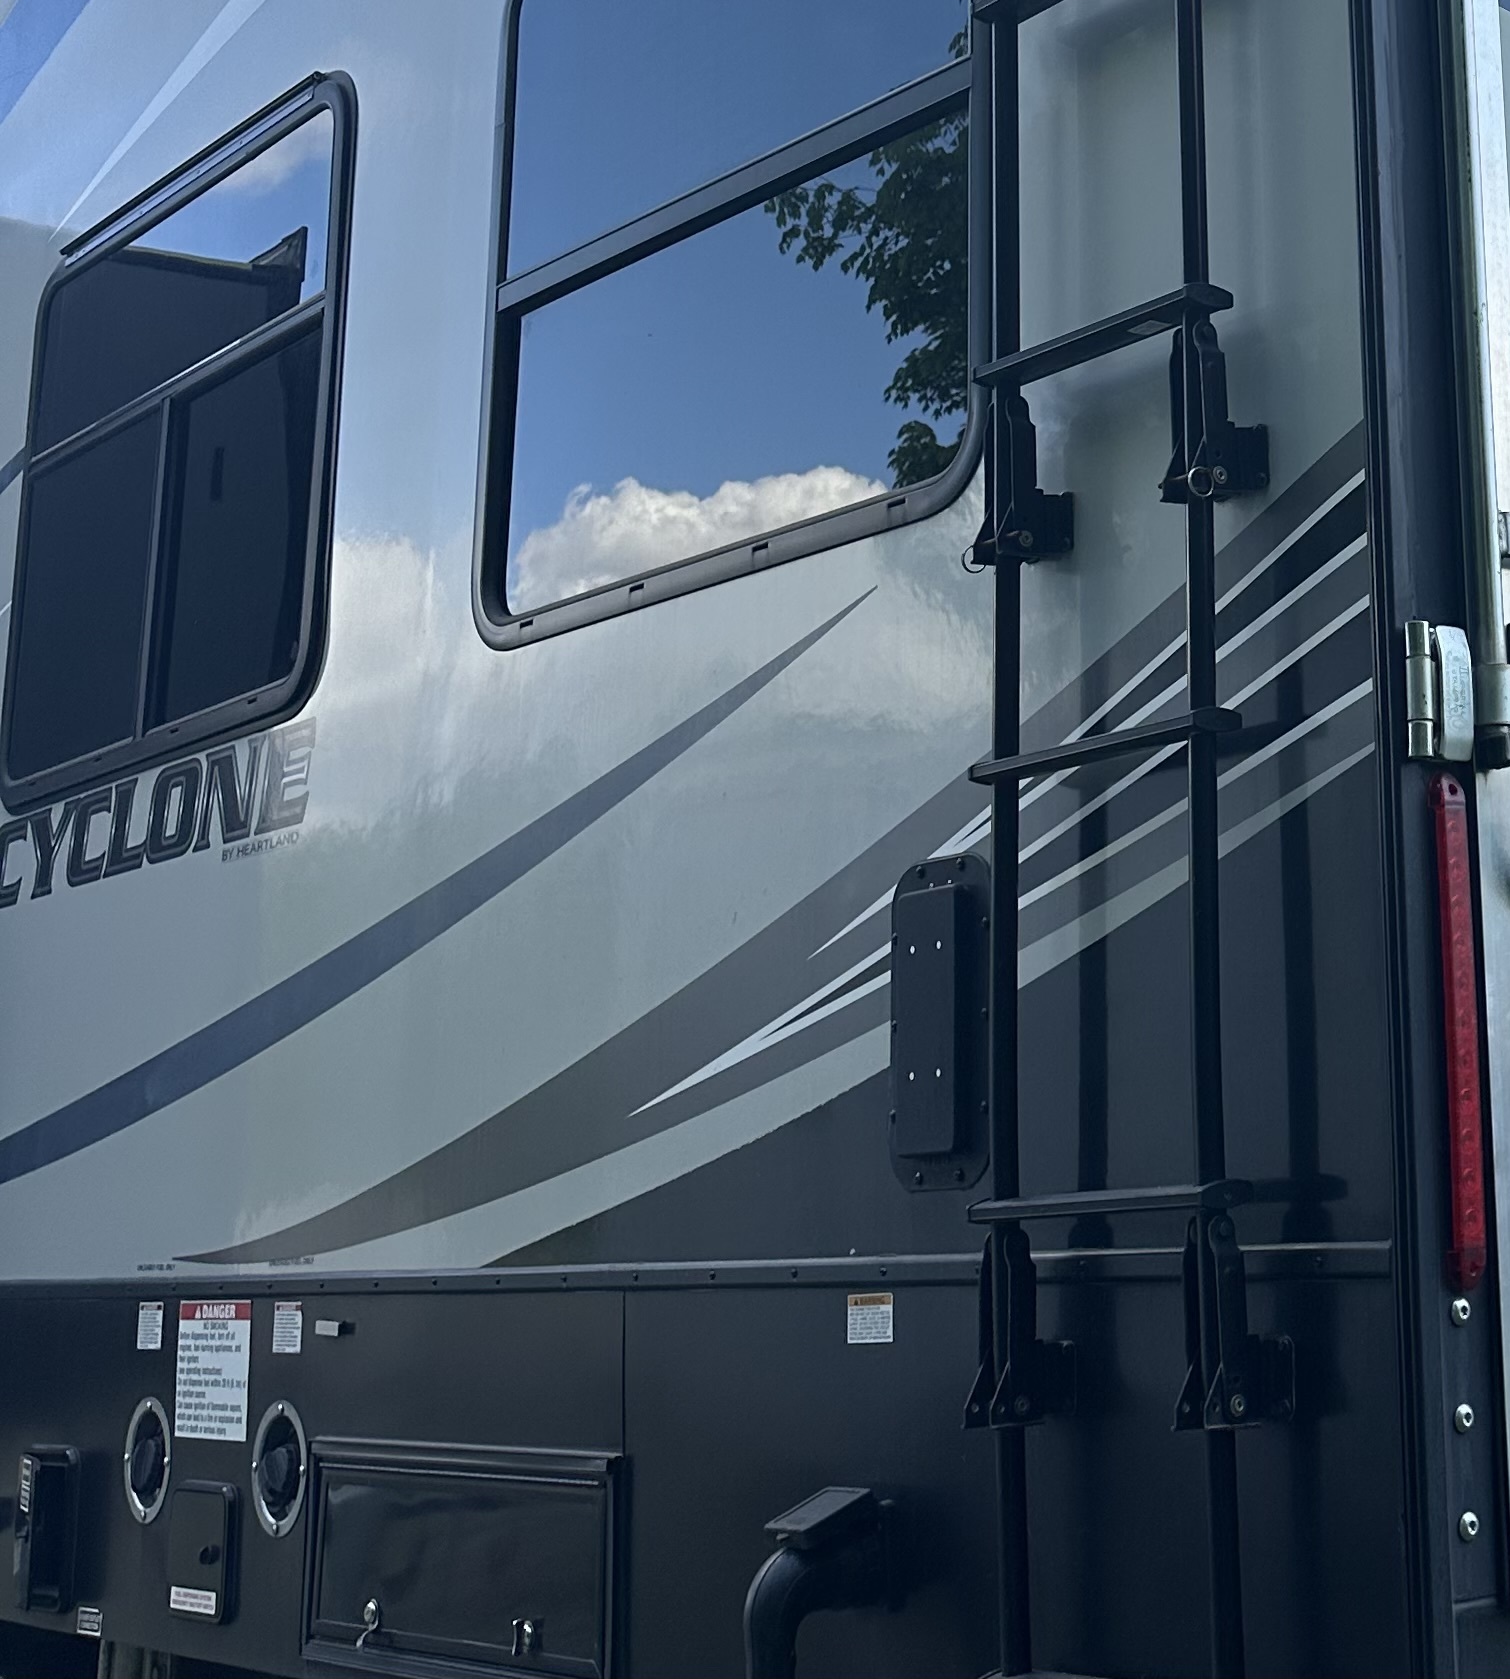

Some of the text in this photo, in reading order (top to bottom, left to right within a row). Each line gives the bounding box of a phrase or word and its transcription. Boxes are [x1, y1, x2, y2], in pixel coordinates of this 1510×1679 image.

[0, 716, 316, 909] CYCLONE
[222, 831, 300, 862] BY HEARTLAND
[202, 1304, 236, 1319] DANGER
